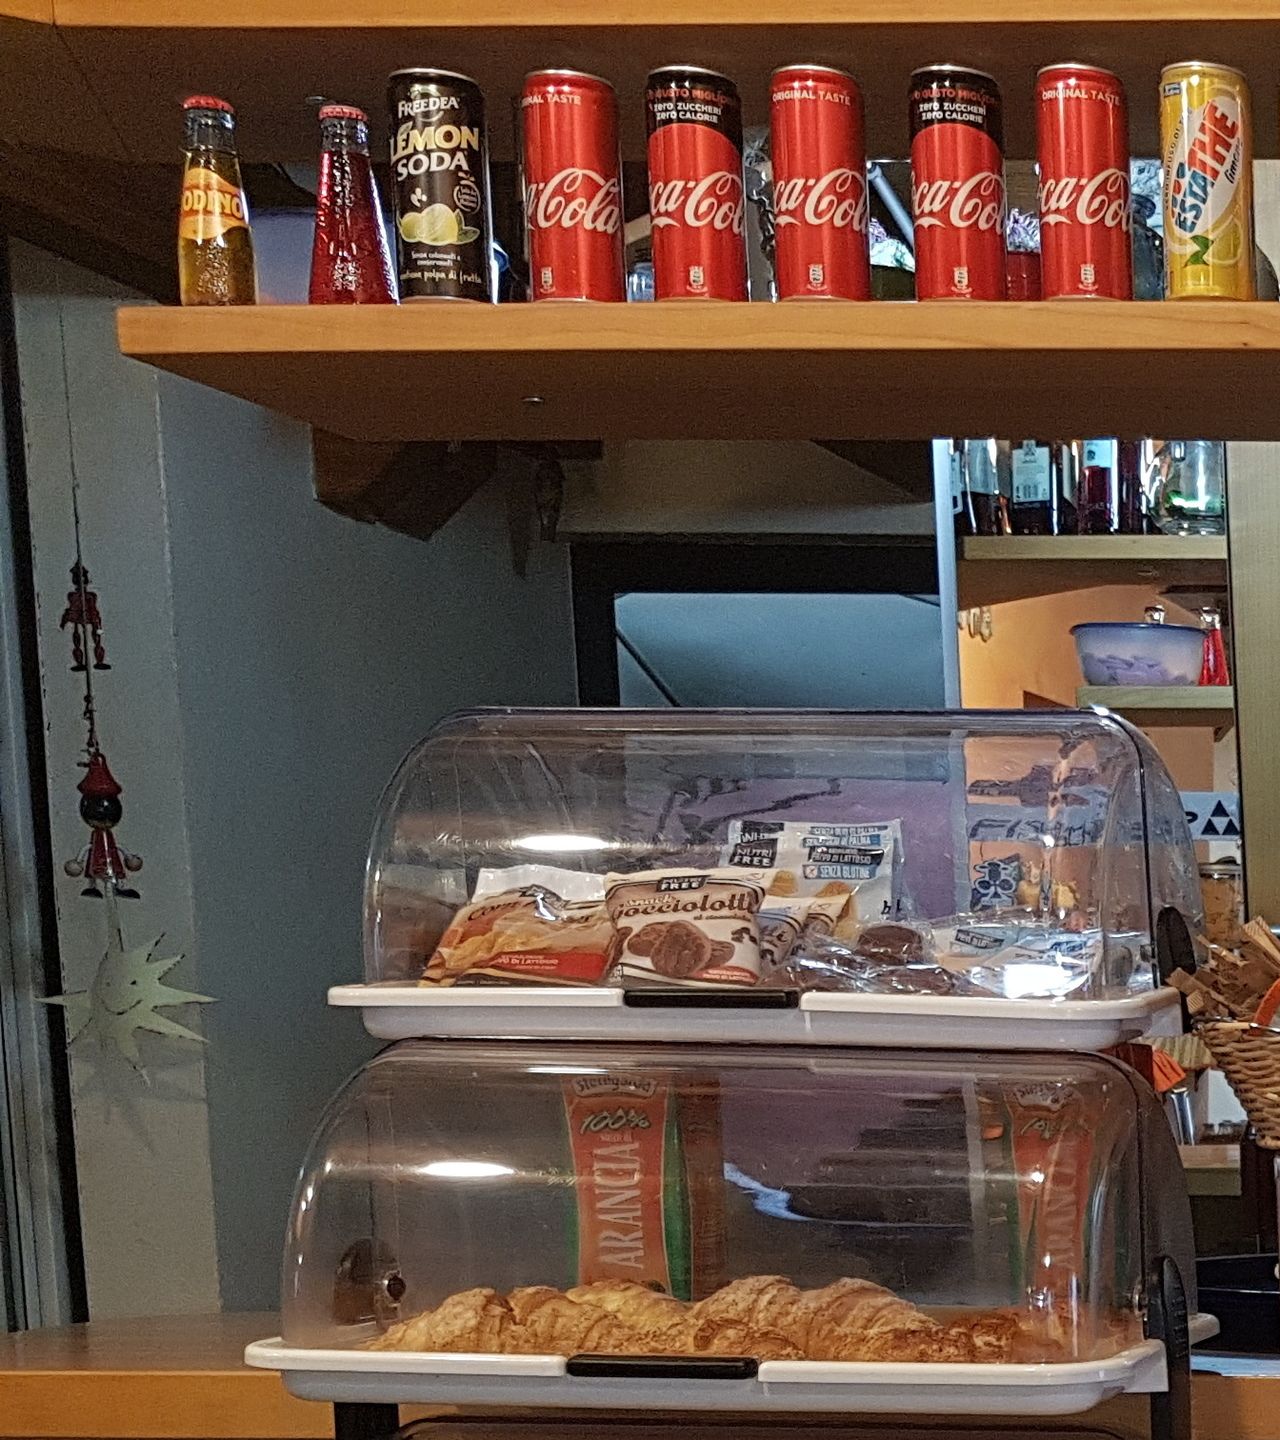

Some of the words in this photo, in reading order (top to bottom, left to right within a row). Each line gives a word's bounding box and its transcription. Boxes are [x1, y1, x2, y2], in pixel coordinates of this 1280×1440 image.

[772, 90, 815, 101] ORIGINAL
[398, 96, 458, 118] FREEDEA
[676, 103, 722, 115] ZUCCHERI
[679, 112, 718, 123] CALORIE
[945, 111, 983, 123] CALORIE
[390, 122, 479, 163] LEMON
[397, 151, 469, 181] SODA
[183, 188, 244, 219] ODINO
[735, 847, 773, 858] NUTRI
[732, 857, 771, 867] FREE
[661, 882, 701, 891] FREE
[580, 1107, 651, 1134] 100%
[593, 1142, 645, 1270] ARANCIA
